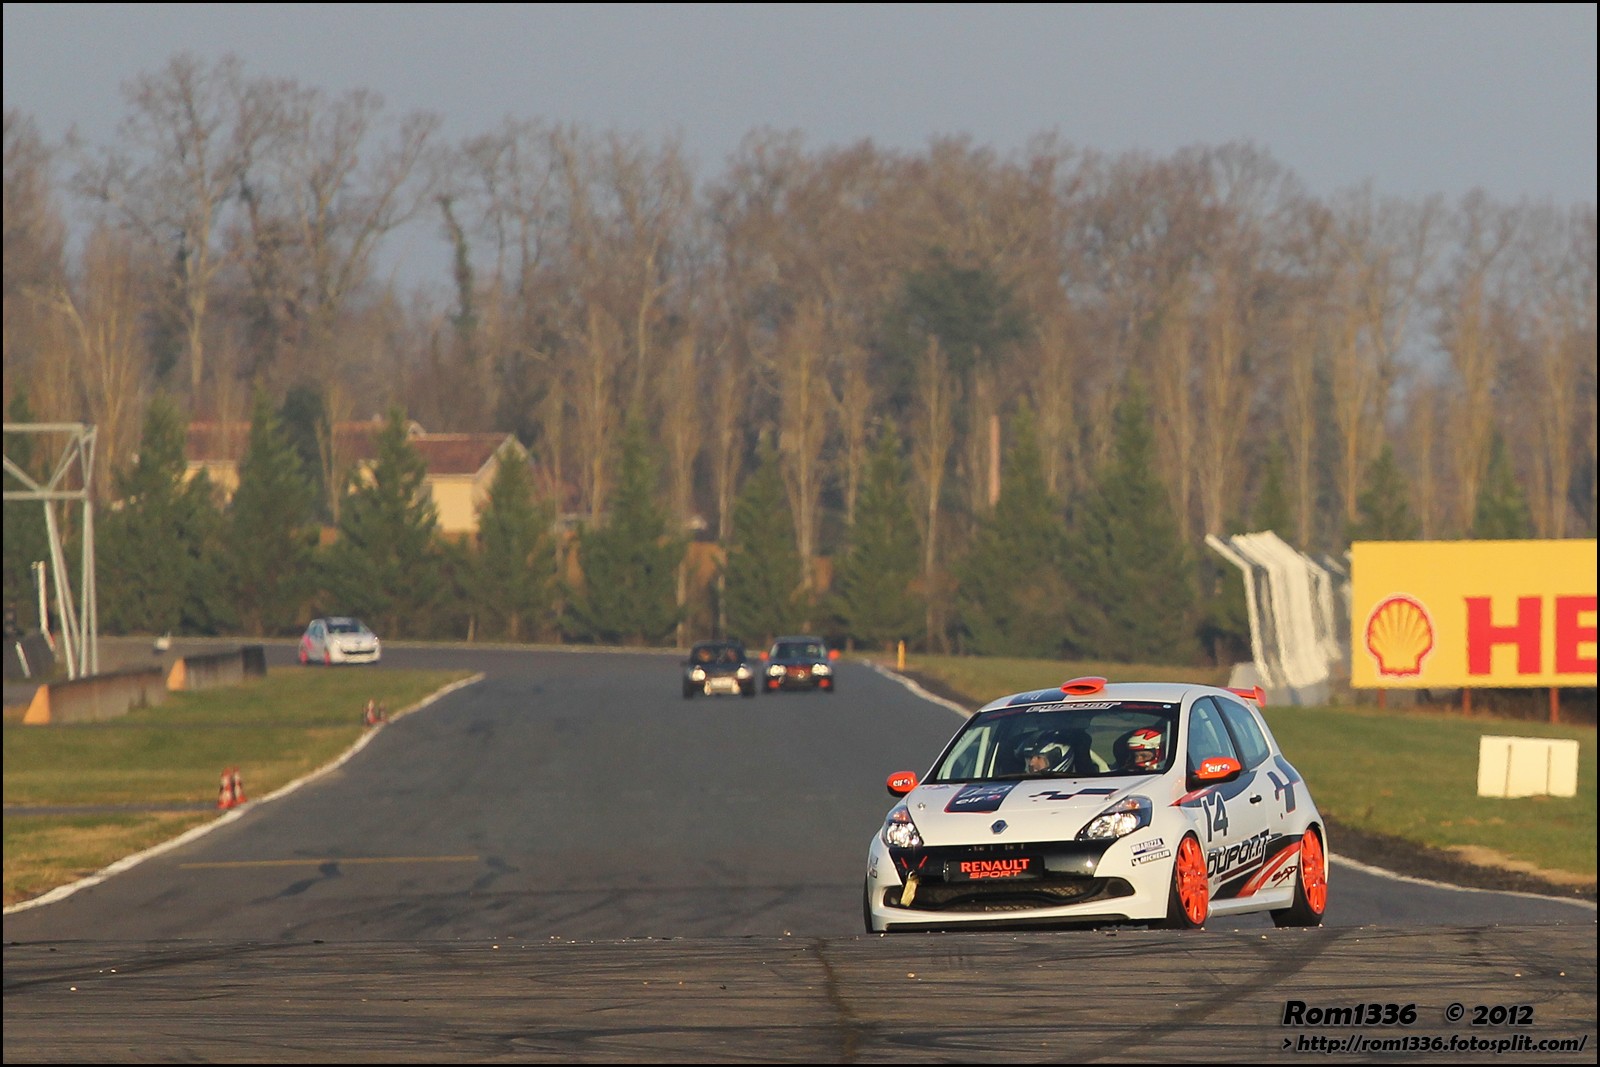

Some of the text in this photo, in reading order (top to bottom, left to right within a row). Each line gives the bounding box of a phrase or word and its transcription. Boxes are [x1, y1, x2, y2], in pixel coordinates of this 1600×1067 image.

[1201, 790, 1229, 843] 14
[1140, 850, 1170, 864] MICHELIN
[960, 859, 1030, 873] RENAULT
[969, 870, 1021, 879] SPORT
